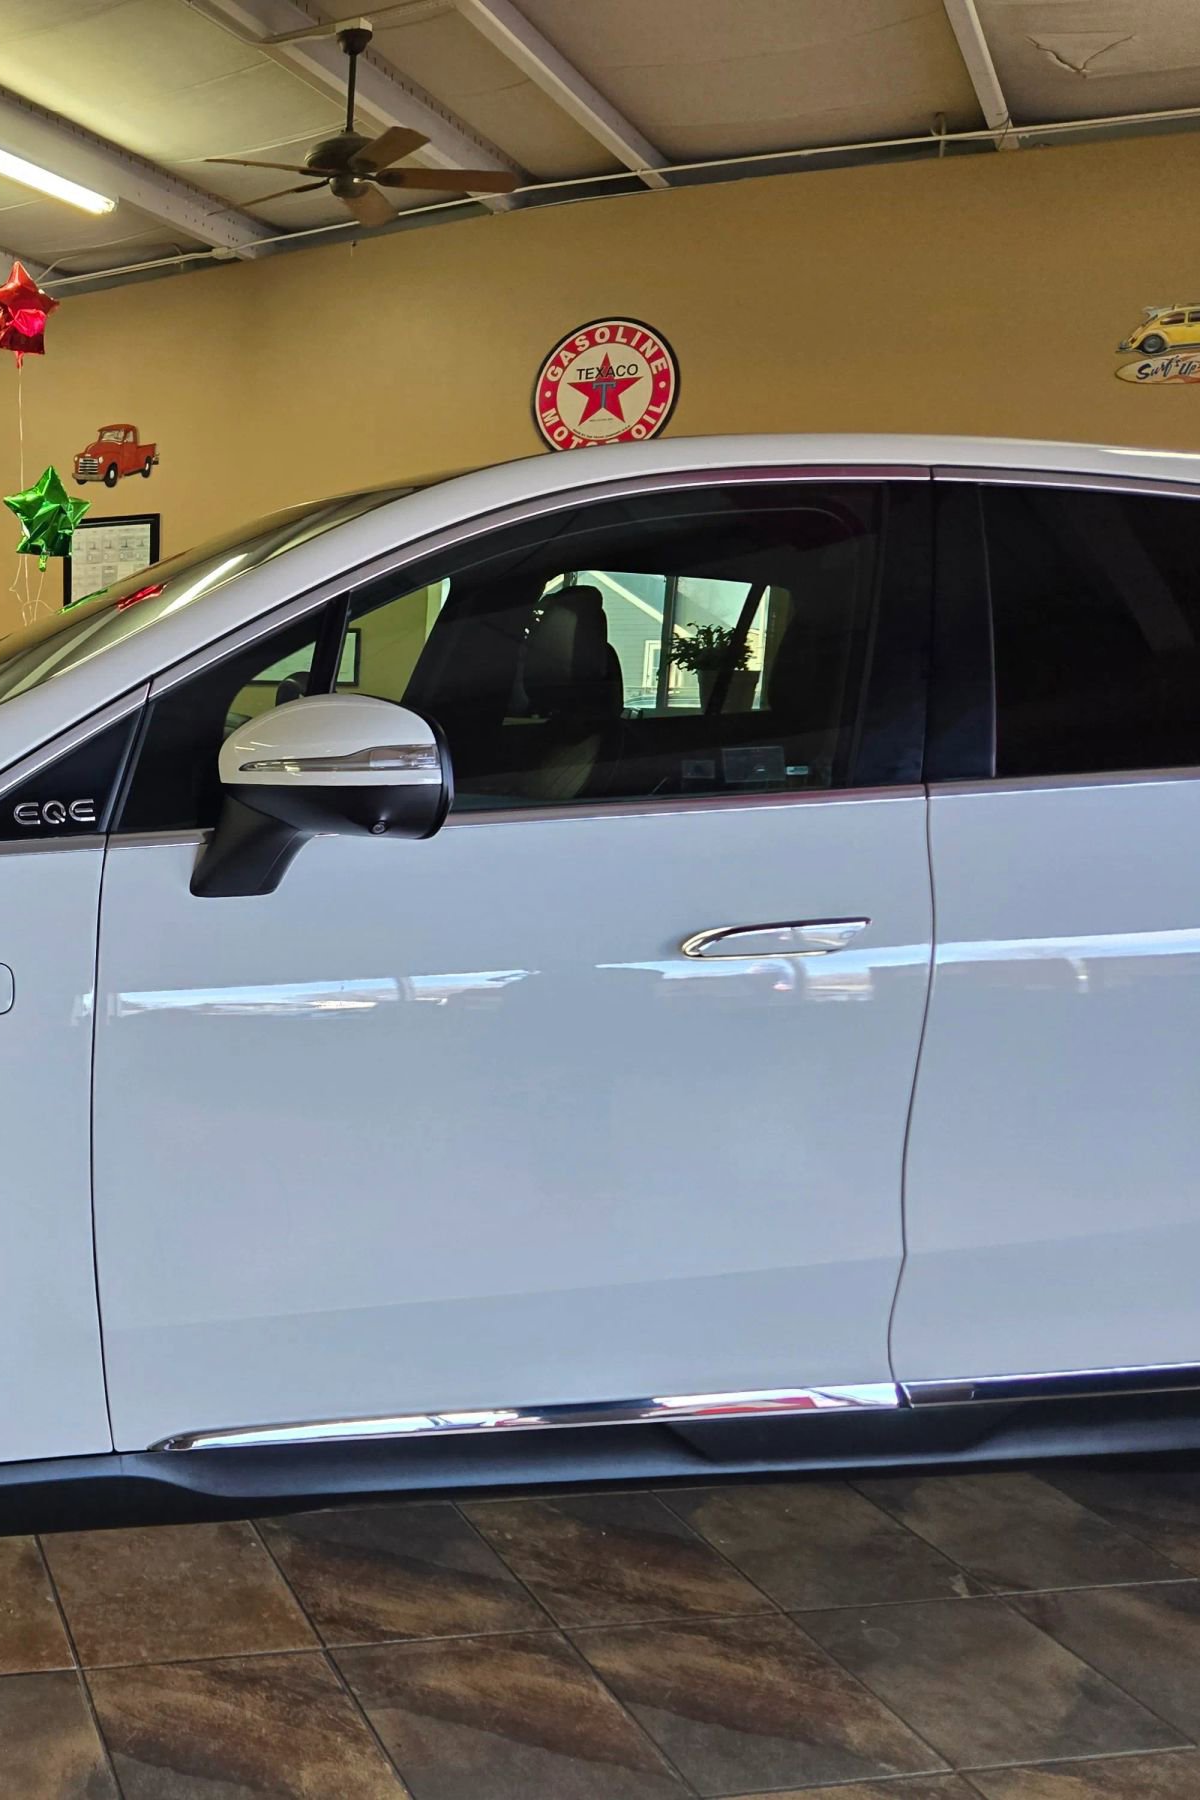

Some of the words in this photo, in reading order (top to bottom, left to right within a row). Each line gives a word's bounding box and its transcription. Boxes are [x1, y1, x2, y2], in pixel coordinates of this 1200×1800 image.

[546, 327, 668, 382] GASOLINE
[576, 363, 639, 380] TEXACO
[542, 407, 620, 449] MOT
[631, 402, 665, 439] OIL
[13, 799, 96, 824] EQE
